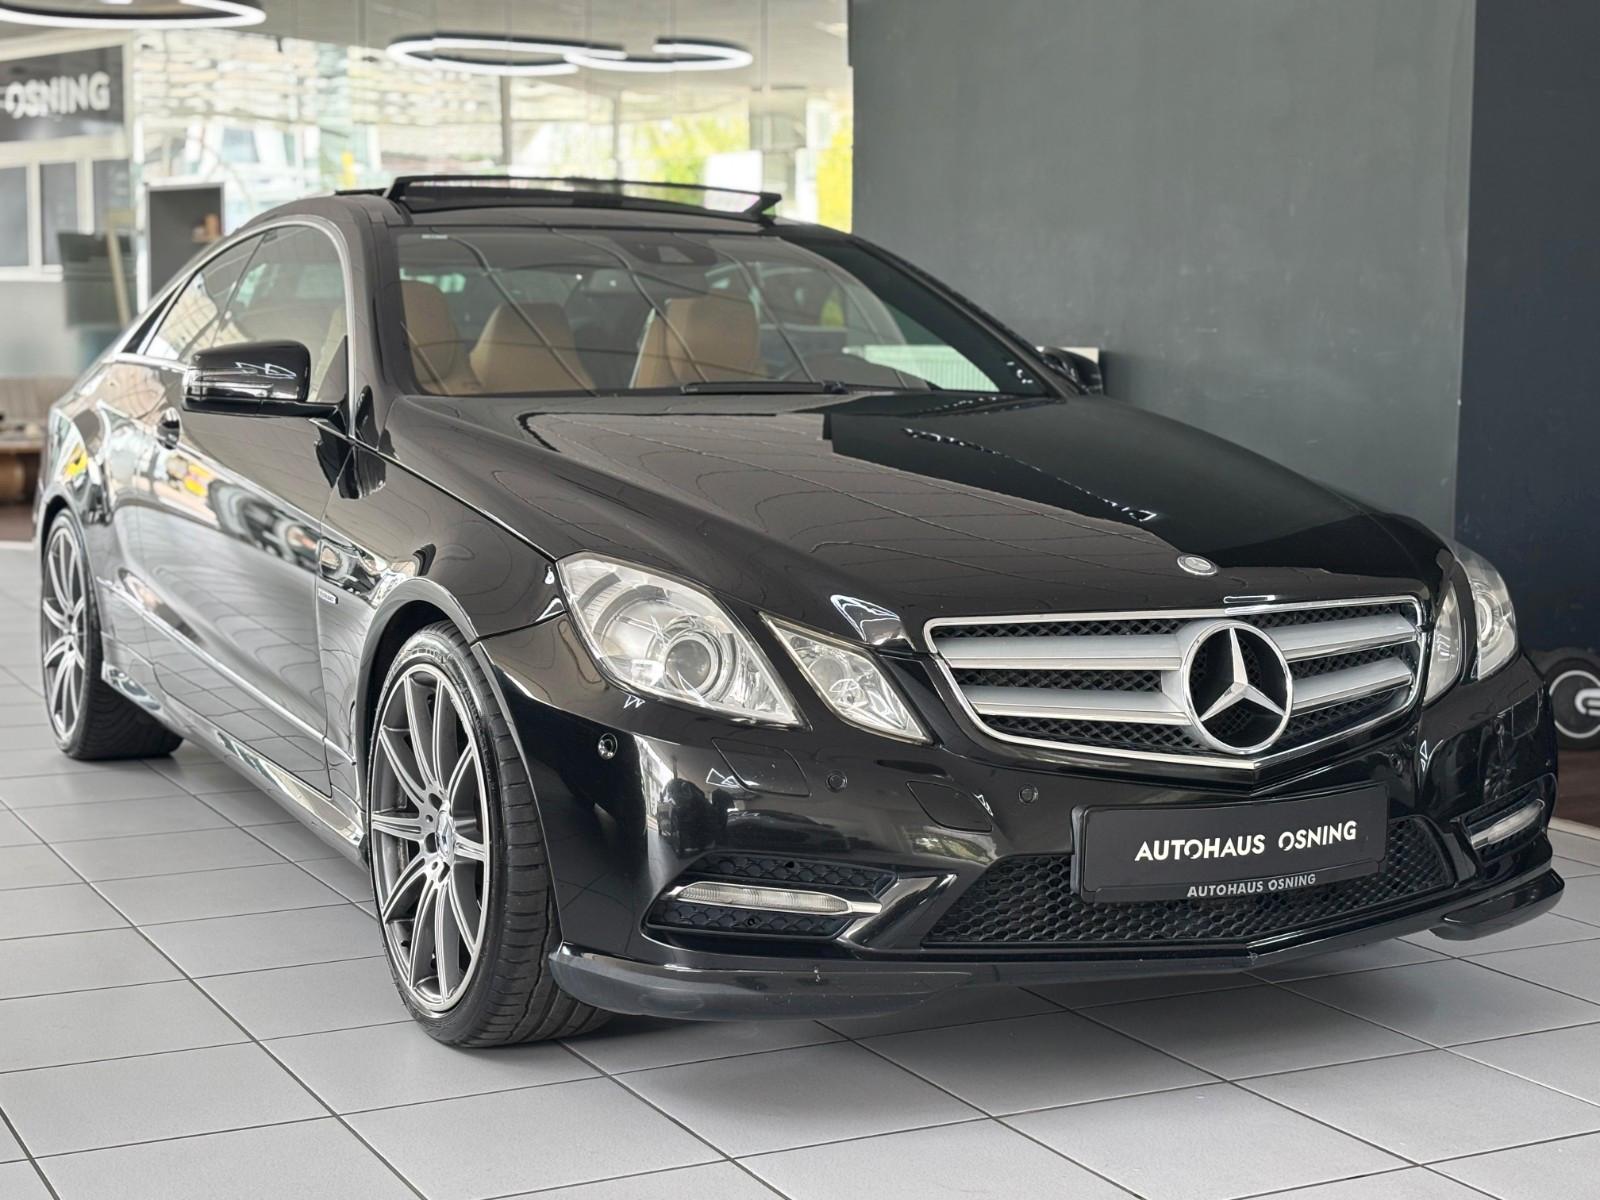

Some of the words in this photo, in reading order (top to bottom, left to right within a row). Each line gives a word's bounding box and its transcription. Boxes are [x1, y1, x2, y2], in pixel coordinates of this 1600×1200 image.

[5, 71, 110, 119] OSNING
[1134, 833, 1266, 862] AUTOHAUS
[1277, 820, 1358, 852] OSNING
[1187, 880, 1264, 898] AUTOHAUS
[1267, 873, 1317, 891] OSNING
